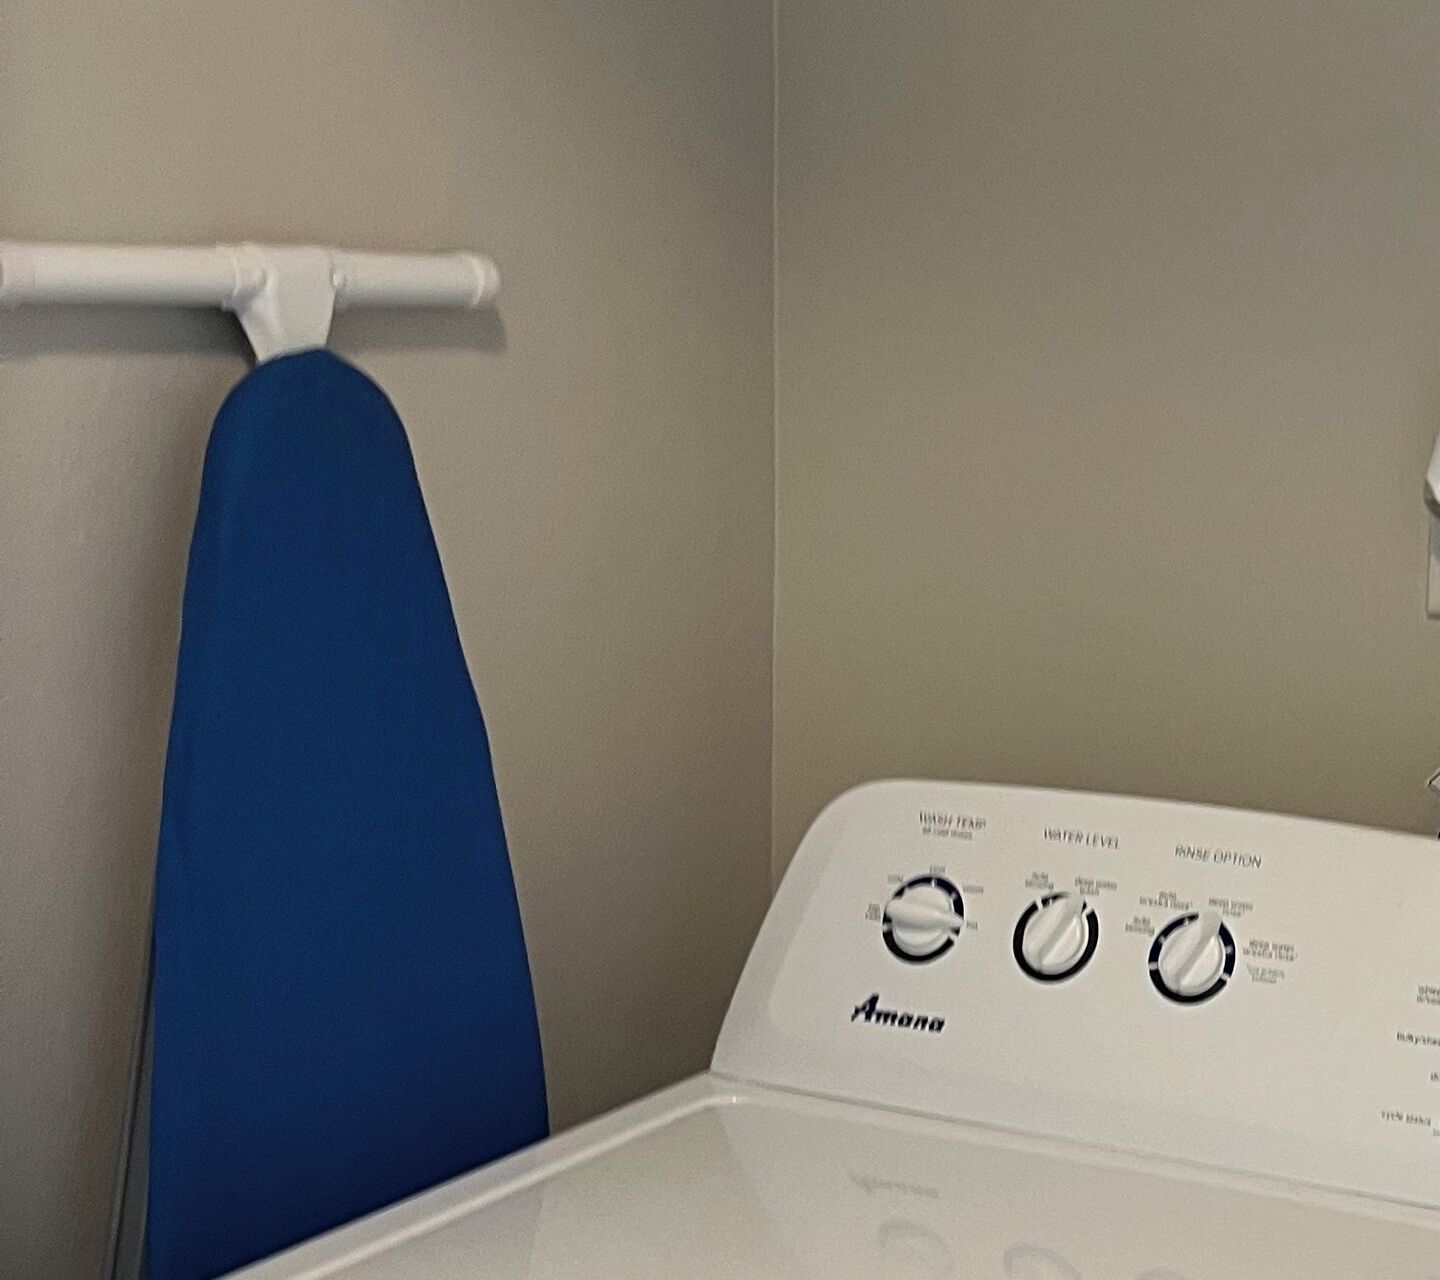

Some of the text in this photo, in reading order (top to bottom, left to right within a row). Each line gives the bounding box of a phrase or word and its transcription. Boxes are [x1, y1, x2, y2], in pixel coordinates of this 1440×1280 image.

[1085, 831, 1120, 851] LEVEL
[1213, 849, 1262, 870] OPTION
[850, 991, 946, 1034] Amana
